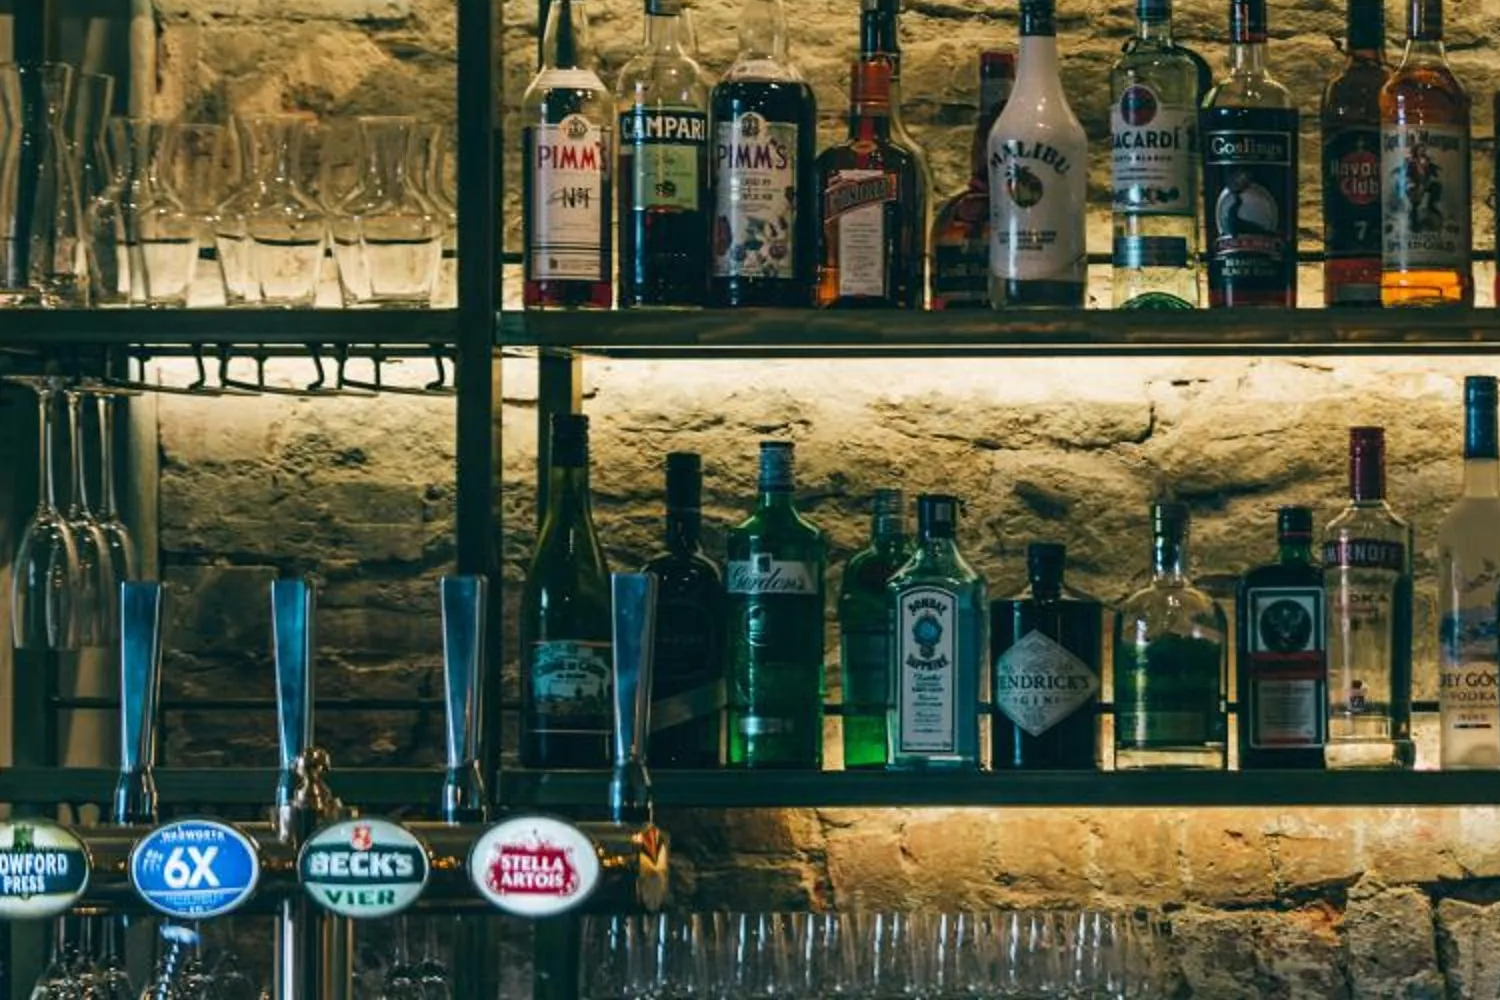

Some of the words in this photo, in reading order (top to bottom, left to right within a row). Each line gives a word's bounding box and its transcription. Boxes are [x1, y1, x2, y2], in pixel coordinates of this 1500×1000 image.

[624, 115, 706, 142] CAMPARI
[717, 138, 788, 170] PIMM'S
[990, 140, 1071, 175] MALIBU
[1330, 160, 1380, 177] Hava
[1342, 177, 1379, 195] Club
[1355, 220, 1367, 241] 7
[1325, 543, 1399, 563] MIRNOFF
[999, 674, 1089, 690] ENDRICK'S
[0, 853, 68, 876] OWFORD
[163, 846, 220, 889] 6X
[309, 850, 414, 878] BECK'S
[501, 853, 563, 872] STELLA
[4, 875, 45, 894] PRESS
[501, 871, 564, 888] ARTOIS
[324, 888, 395, 905] VIER
